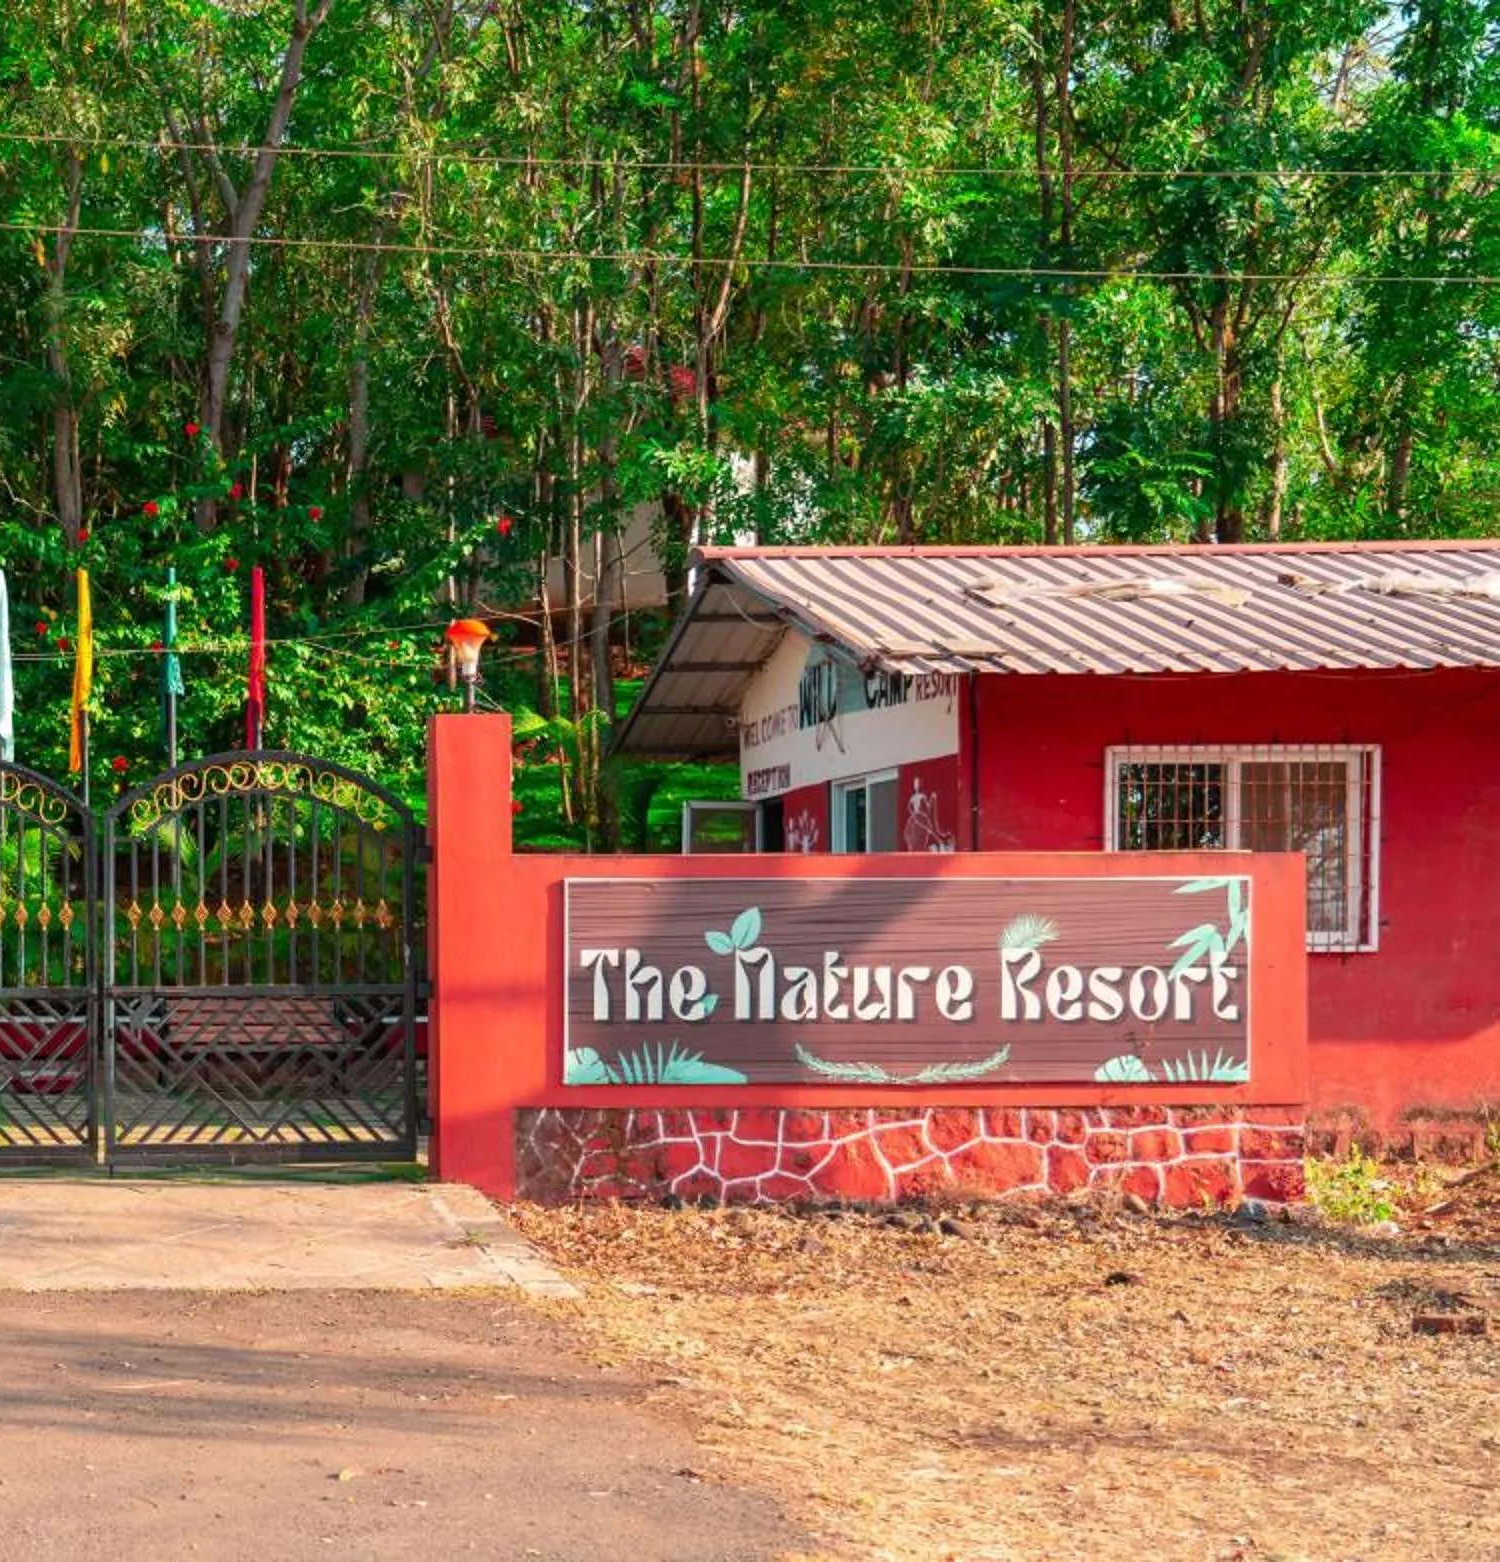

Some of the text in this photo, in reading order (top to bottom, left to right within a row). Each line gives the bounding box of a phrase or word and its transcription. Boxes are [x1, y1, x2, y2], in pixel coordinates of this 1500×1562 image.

[799, 661, 837, 730] WILD
[580, 946, 1240, 1022] The Nature Resort
